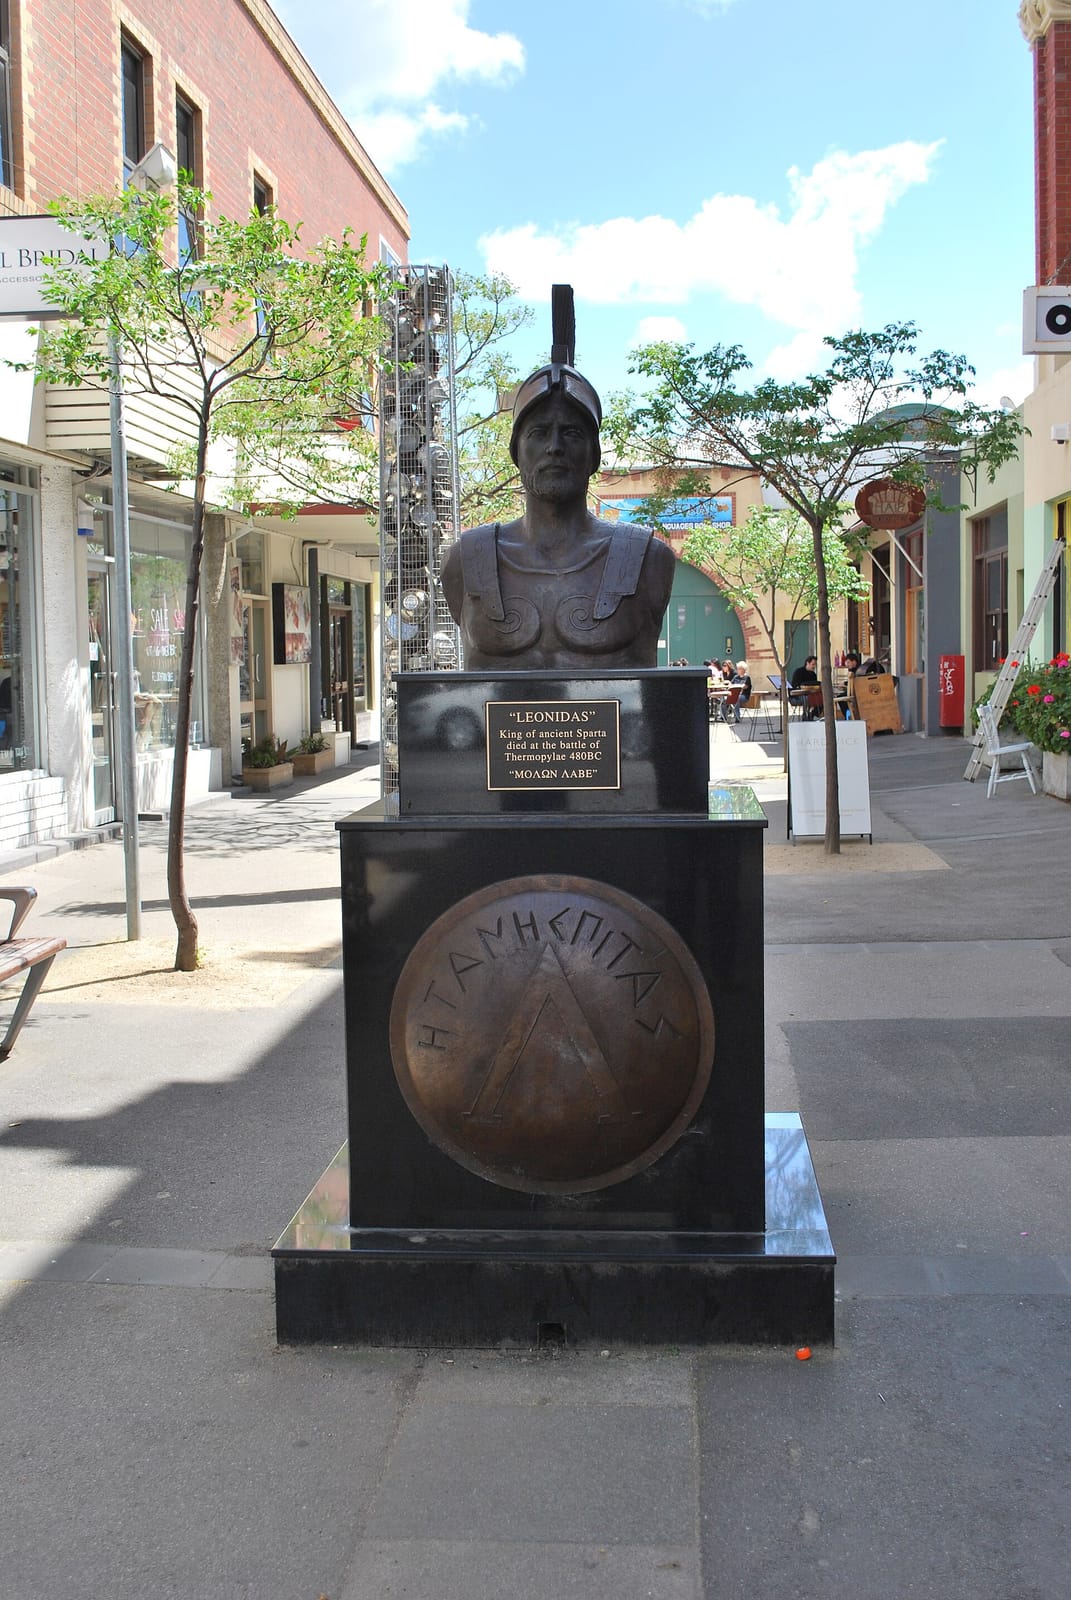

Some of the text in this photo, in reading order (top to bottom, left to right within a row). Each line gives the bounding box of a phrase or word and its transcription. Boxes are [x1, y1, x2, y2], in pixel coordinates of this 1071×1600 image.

[499, 728, 606, 740] King of ancient Sparta
[506, 740, 600, 750] died at the battle of
[504, 751, 602, 763] Thermopylae 480BC
